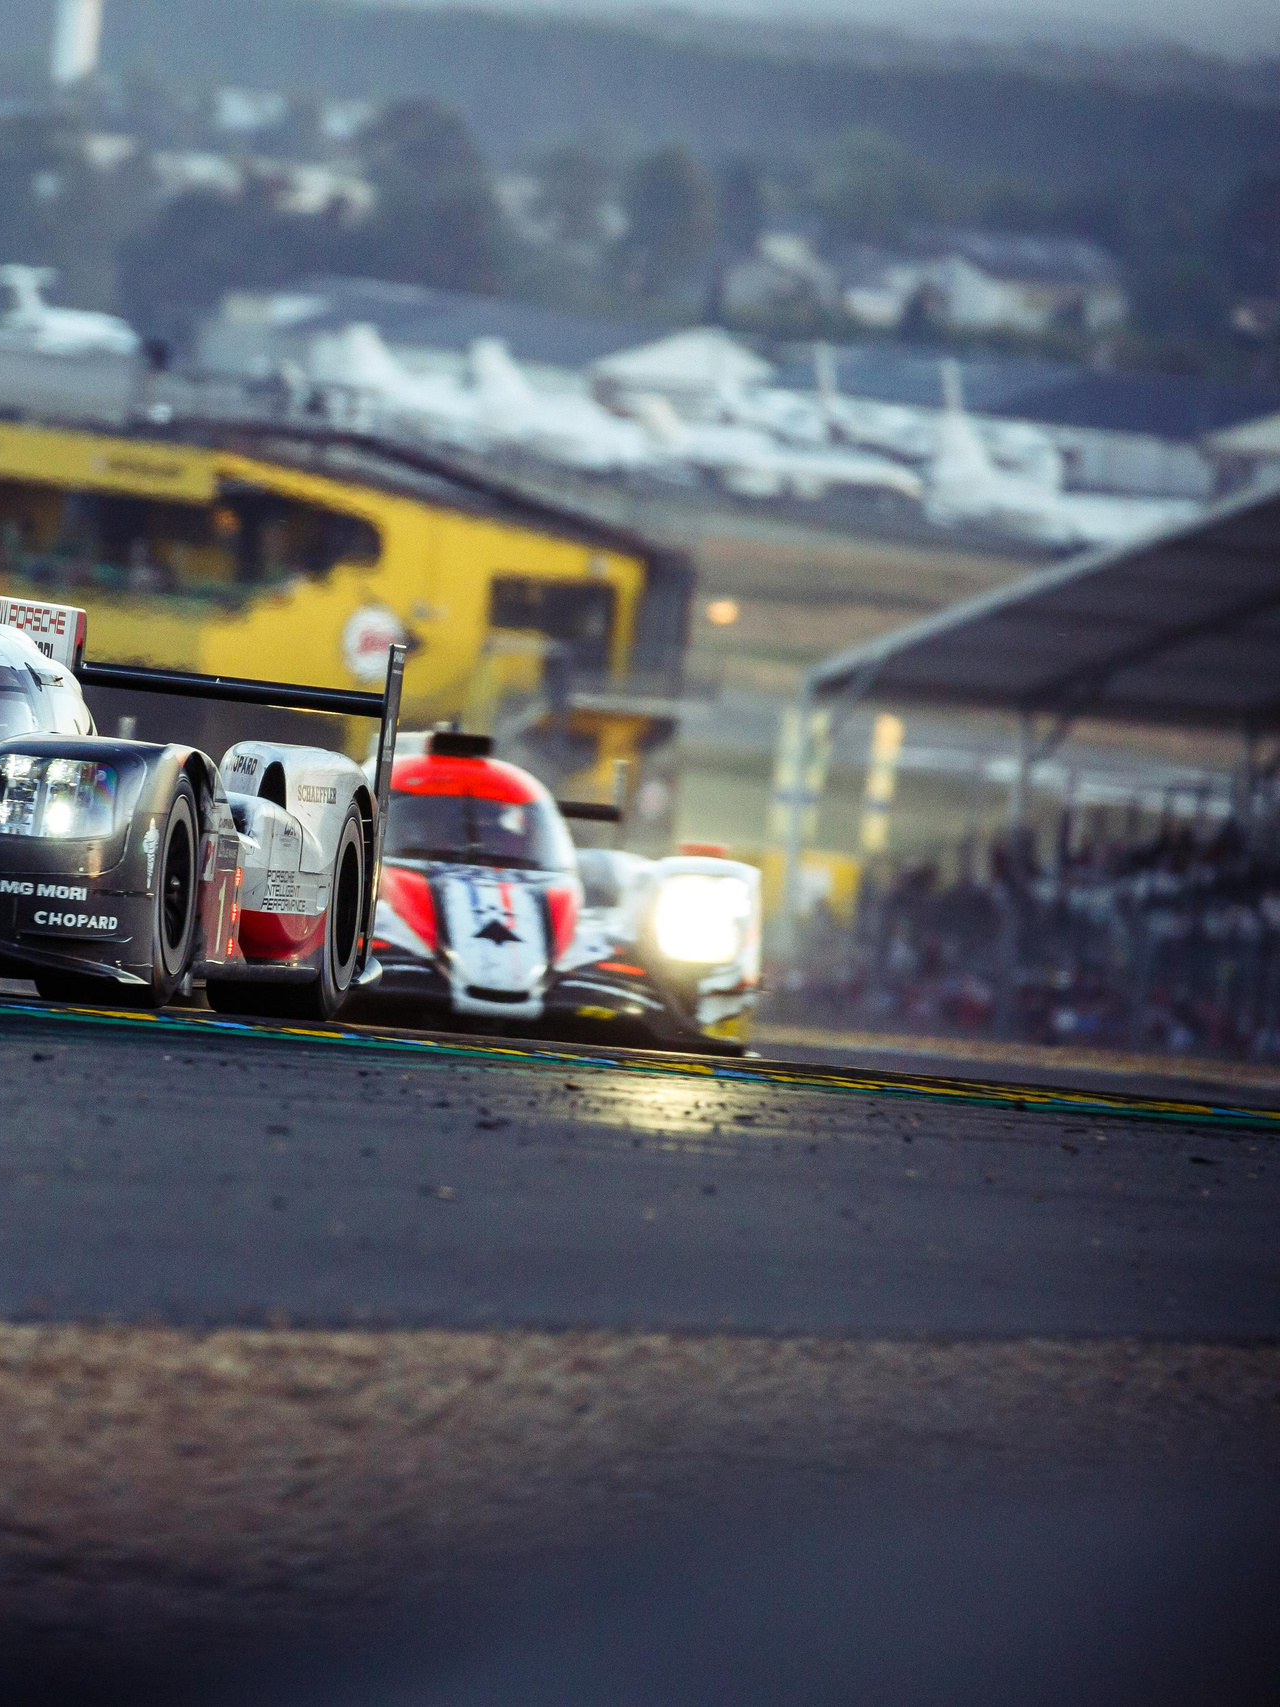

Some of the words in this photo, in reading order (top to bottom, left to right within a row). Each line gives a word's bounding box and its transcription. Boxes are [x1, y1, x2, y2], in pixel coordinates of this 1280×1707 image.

[7, 604, 67, 635] PORSCHE
[297, 784, 337, 805] SCHAEFFLER
[266, 870, 296, 884] PORSCHE
[36, 883, 88, 901] MORI
[265, 884, 301, 898] INTELLIGENT
[261, 897, 307, 913] PERFORMANCE
[33, 911, 118, 930] CHOPARD
